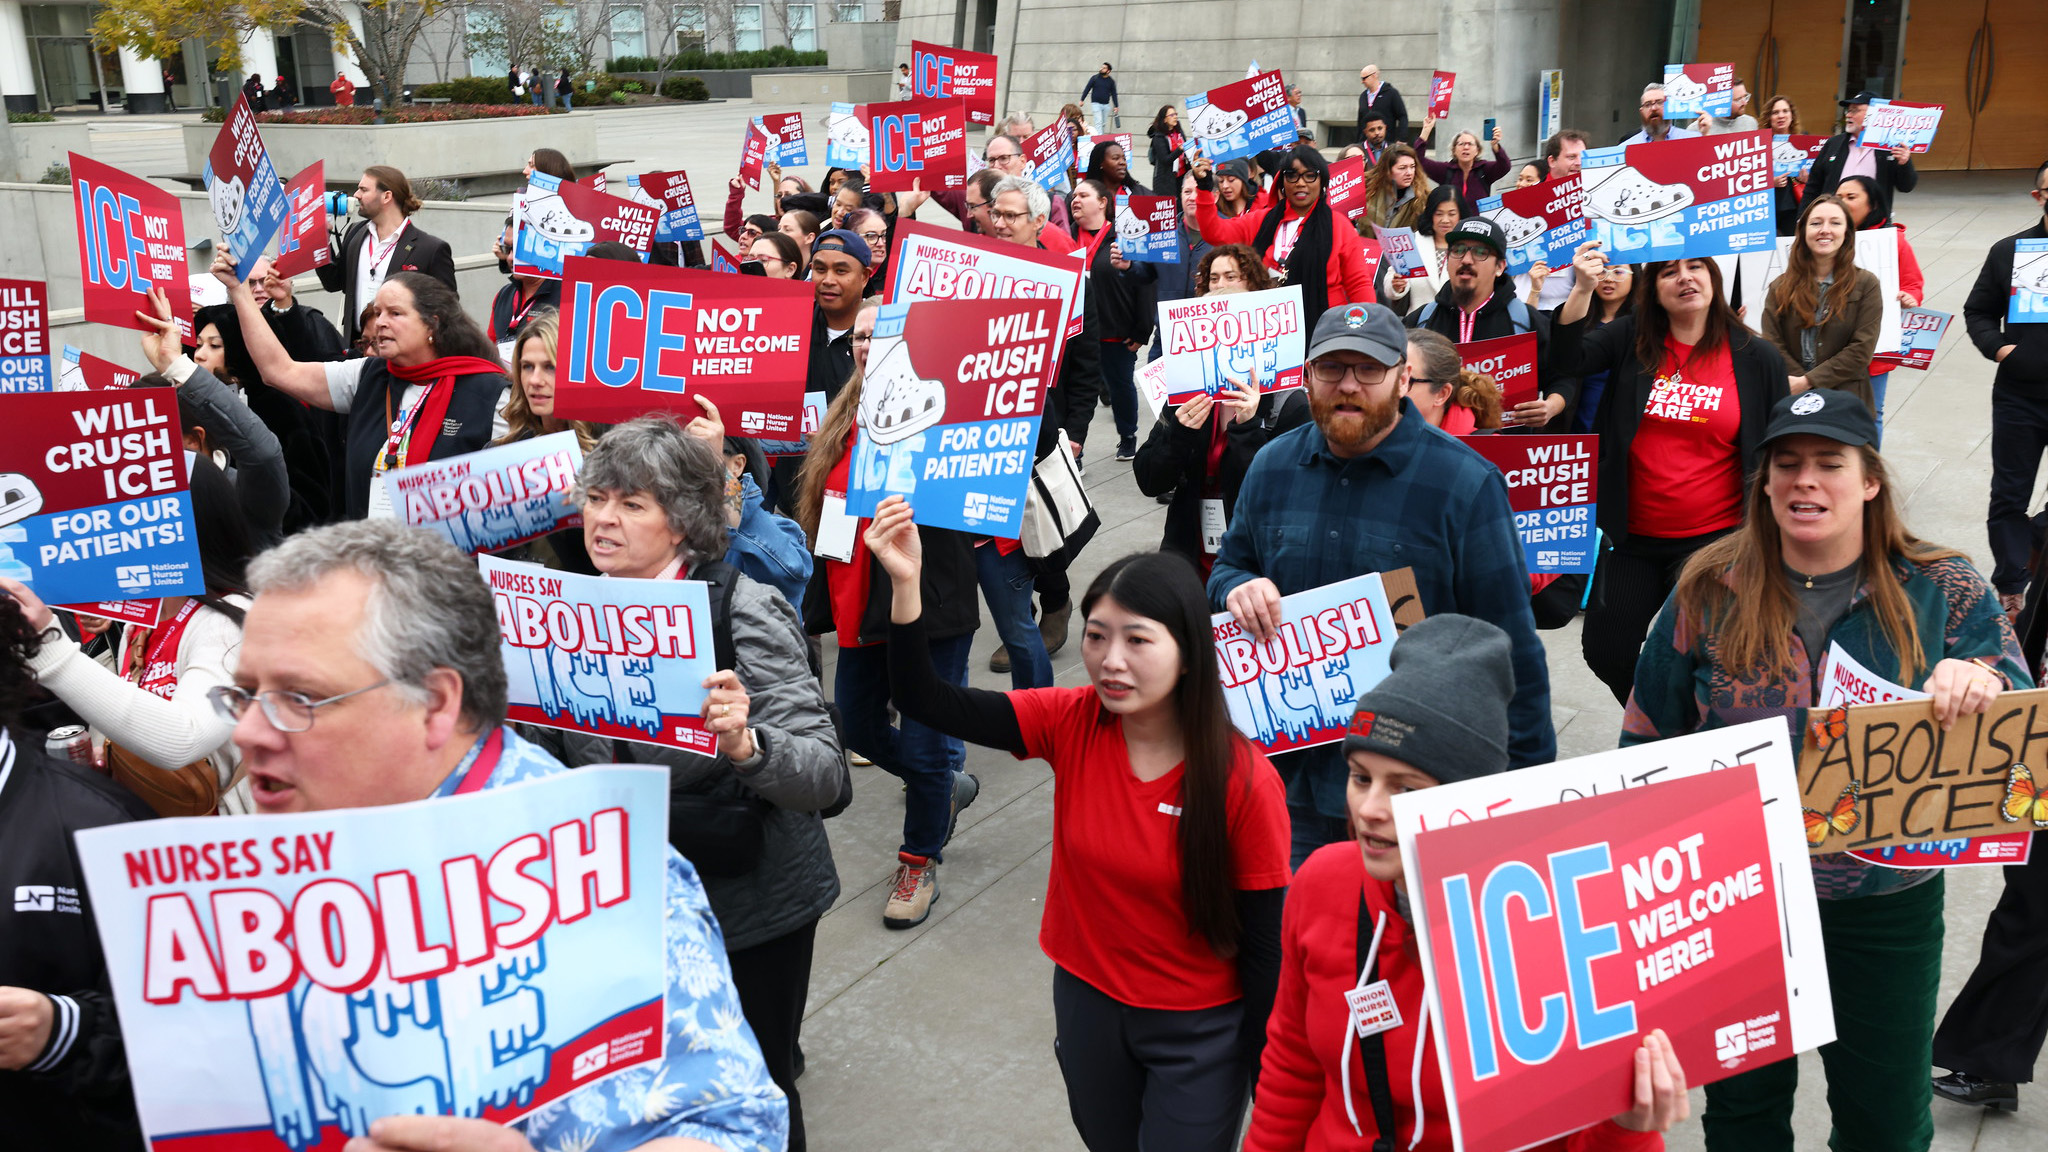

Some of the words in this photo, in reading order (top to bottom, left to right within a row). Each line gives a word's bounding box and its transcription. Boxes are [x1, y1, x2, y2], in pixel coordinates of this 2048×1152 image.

[915, 51, 954, 98] ICE
[954, 65, 979, 76] NOT
[953, 78, 993, 86] WELCOME
[953, 87, 975, 95] HERE!
[1251, 74, 1280, 93] WILL
[1717, 80, 1732, 91] ICE
[1245, 83, 1282, 108] CRUSH
[1262, 94, 1286, 113] ICE
[231, 104, 248, 140] WILL
[780, 122, 801, 134] CRUSH
[785, 114, 800, 125] WILL
[922, 116, 947, 135] NOT
[1248, 115, 1290, 140] PATIENTS!
[1250, 118, 1268, 130] FOR
[1269, 107, 1288, 120] OUR
[1873, 114, 1935, 130] ABOLISH
[234, 118, 254, 167] CRUSH
[789, 130, 802, 141] ICE
[872, 114, 924, 172] ICE
[923, 128, 962, 147] WELCOME
[1034, 134, 1056, 157] CRUSH
[1037, 128, 1054, 144] WILL
[247, 140, 262, 170] ICE
[924, 145, 947, 159] HERE!
[1043, 144, 1057, 160] ICE
[1713, 136, 1767, 161] WILL
[1697, 152, 1767, 183] CRUSH
[249, 182, 262, 204] FOR
[258, 156, 269, 182] OUR
[666, 174, 686, 187] WILL
[1329, 171, 1348, 189] NOT
[1329, 176, 1362, 197] WELCOME
[1552, 177, 1582, 197] WILL
[1727, 170, 1768, 195] ICE
[664, 186, 689, 199] CRUSH
[676, 194, 692, 207] ICE
[1330, 191, 1349, 206] HERE!
[618, 205, 654, 223] WILL
[670, 211, 682, 220] FOR
[683, 207, 695, 217] OUR
[1155, 199, 1174, 210] WILL
[1697, 202, 1731, 219] FOR
[1733, 192, 1768, 210] OUR
[1150, 209, 1175, 222] CRUSH
[1160, 218, 1175, 231] ICE
[1689, 206, 1769, 236] PATIENTS!
[79, 179, 153, 295] ICE
[144, 216, 168, 240] NOT
[600, 217, 653, 237] CRUSH
[1150, 233, 1162, 241] FOR
[1163, 231, 1176, 239] OUR
[1550, 227, 1571, 240] FOR
[618, 233, 649, 251] ICE
[1548, 229, 1586, 252] PATIENT
[148, 243, 184, 262] WELCOME
[917, 245, 959, 263] NURSES
[960, 253, 980, 267] SAY
[151, 263, 173, 280] HERE!
[907, 260, 1062, 300] ABOLISH
[0, 288, 39, 307] ILL
[696, 308, 763, 333] NOT
[1168, 304, 1207, 320] NURSES
[1211, 300, 1229, 314] SAY
[568, 281, 693, 394] ICE
[988, 310, 1049, 347] WILL
[1170, 301, 1297, 355] ABOLISH
[0, 331, 42, 354] CE
[694, 335, 800, 354] WELCOME
[2, 358, 43, 375] OUR
[692, 358, 752, 376] HERE!
[957, 343, 1046, 384] CRUSH
[1466, 354, 1506, 374] NOT
[984, 377, 1040, 416] ICE
[1653, 378, 1723, 397] ORTION
[72, 398, 168, 437] WILL
[767, 413, 794, 422] National
[1644, 401, 1692, 421] ARE
[939, 427, 981, 452] FOR
[985, 421, 1031, 447] OUR
[46, 428, 171, 473] CRUSH
[1527, 441, 1591, 465] WILL
[449, 461, 471, 479] SAY
[923, 450, 1026, 481] PATIENTS!
[1504, 461, 1589, 488] CRUSH
[104, 459, 177, 499] ICE
[407, 450, 576, 526] ABOLISH
[990, 494, 1017, 506] National
[1540, 482, 1589, 507] ICE
[52, 509, 111, 538] FOR
[119, 498, 181, 529] OUR
[986, 512, 1008, 523] United
[988, 504, 1010, 514] Nurses
[1514, 513, 1542, 529] OR
[1546, 507, 1588, 525] OUR
[40, 522, 185, 566] PATIENTS!
[1519, 523, 1588, 544] TIENTS!
[152, 562, 189, 571] National
[153, 571, 183, 579] Nurses
[154, 578, 184, 586] United
[490, 569, 536, 595] NURSES
[539, 579, 562, 598] SAY
[495, 592, 696, 659] ABOLISH
[1213, 620, 1242, 642] RSES
[529, 645, 663, 738] ICE
[1833, 661, 1877, 703] NURSES
[1805, 704, 2048, 796] ABOLISH
[1847, 778, 2007, 848] ICE
[124, 837, 262, 889] NURSES
[271, 831, 335, 875] SAY
[1621, 832, 1704, 910] NOT
[57, 895, 80, 906] Nurs
[142, 807, 631, 1004] ABOLISH
[1629, 863, 1764, 949] WELCOME
[1441, 841, 1638, 1081] ICE
[1636, 928, 1715, 992] HERE!
[1353, 989, 1385, 1004] UNION
[1357, 1000, 1389, 1015] NURSE
[245, 937, 551, 1151] ICE
